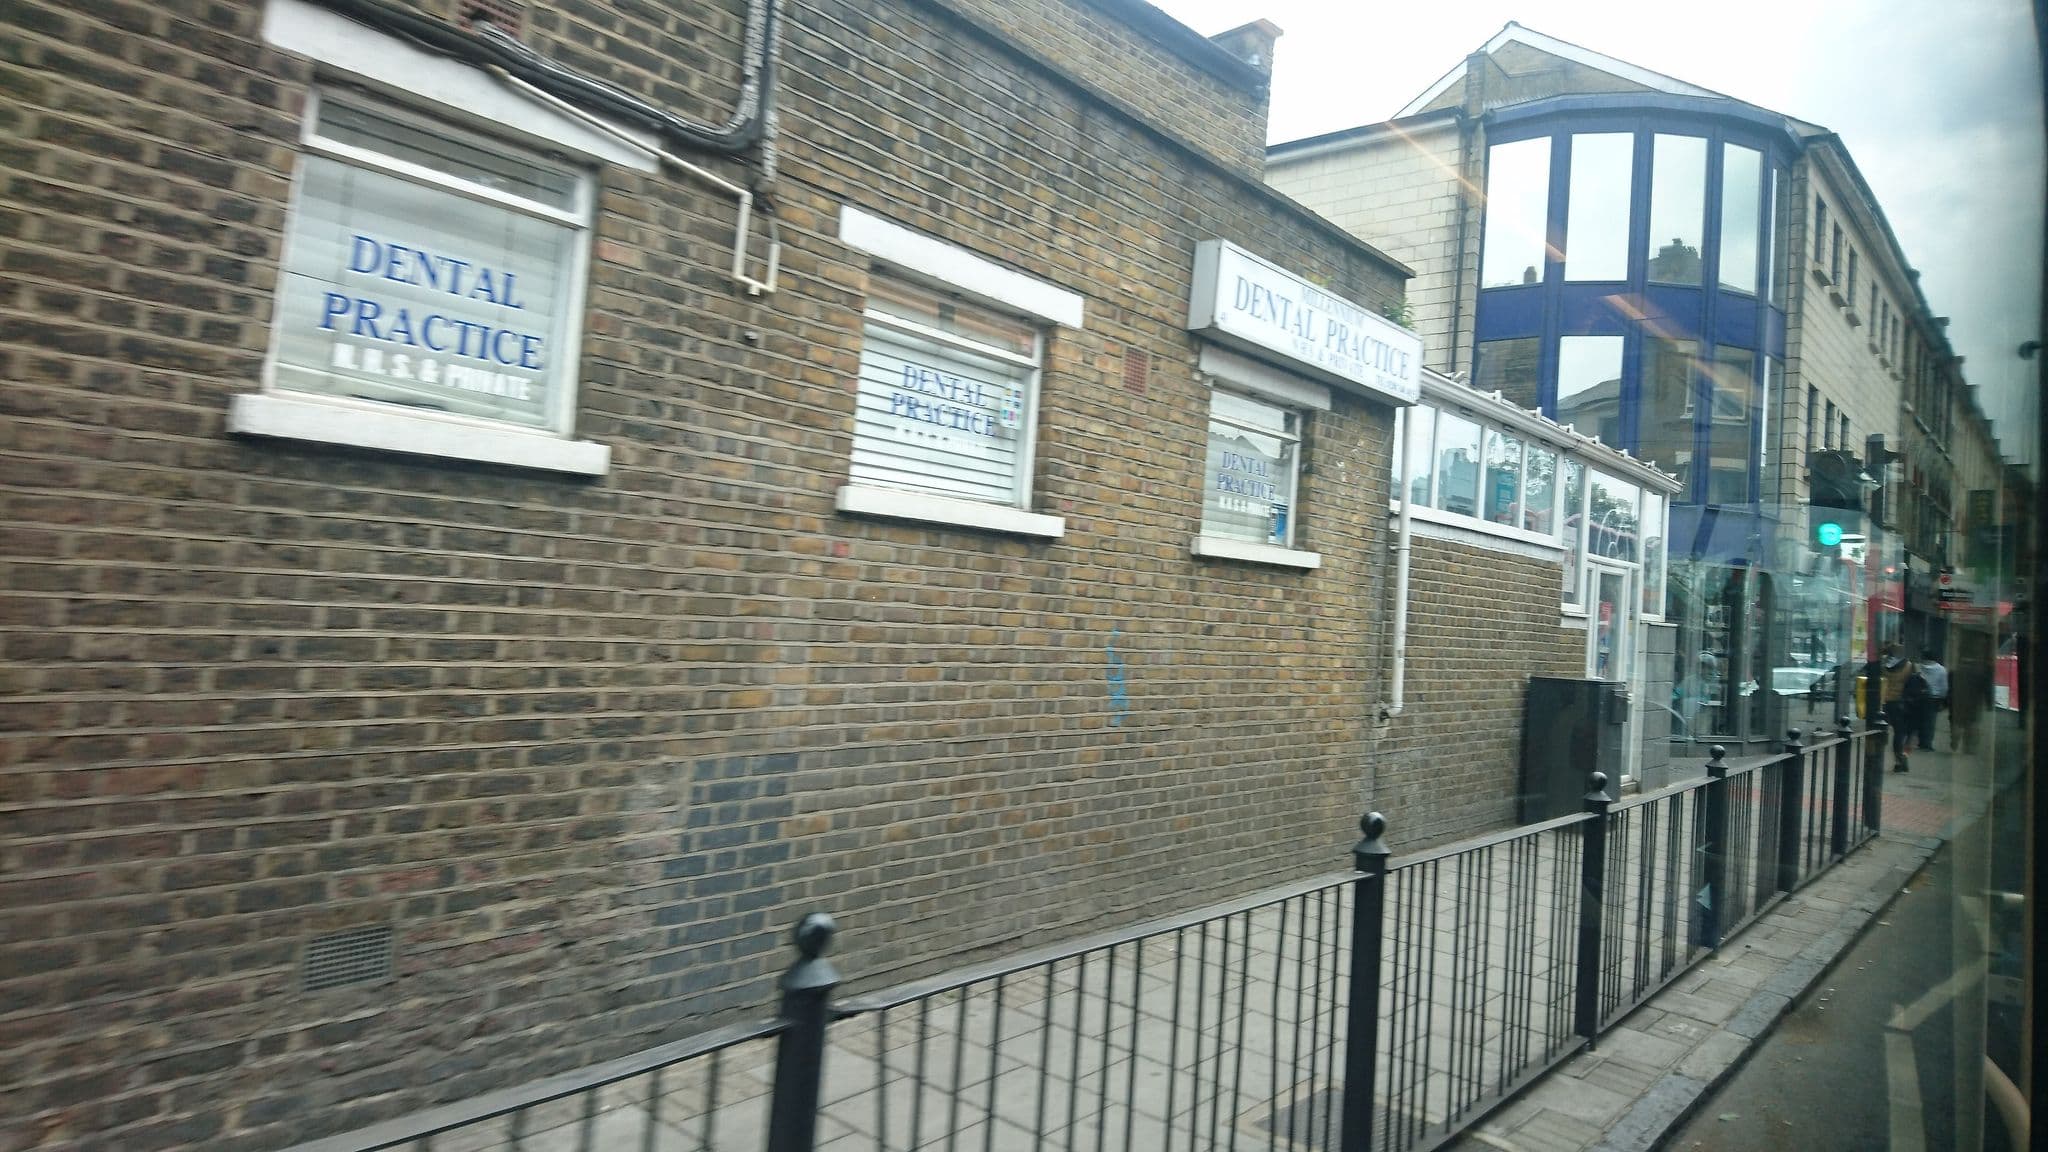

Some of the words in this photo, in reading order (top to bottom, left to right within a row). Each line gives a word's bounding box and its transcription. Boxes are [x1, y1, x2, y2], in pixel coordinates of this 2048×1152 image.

[347, 234, 525, 310] DENTAL
[317, 292, 544, 371] PRACTICE
[1233, 276, 1316, 343] DENTAL
[1325, 318, 1412, 381] PRACTICE
[901, 364, 989, 408] DENTAL
[889, 392, 997, 437] PRACTICE
[1216, 472, 1276, 501] PRACTICE
[1222, 450, 1270, 478] DENTAL
